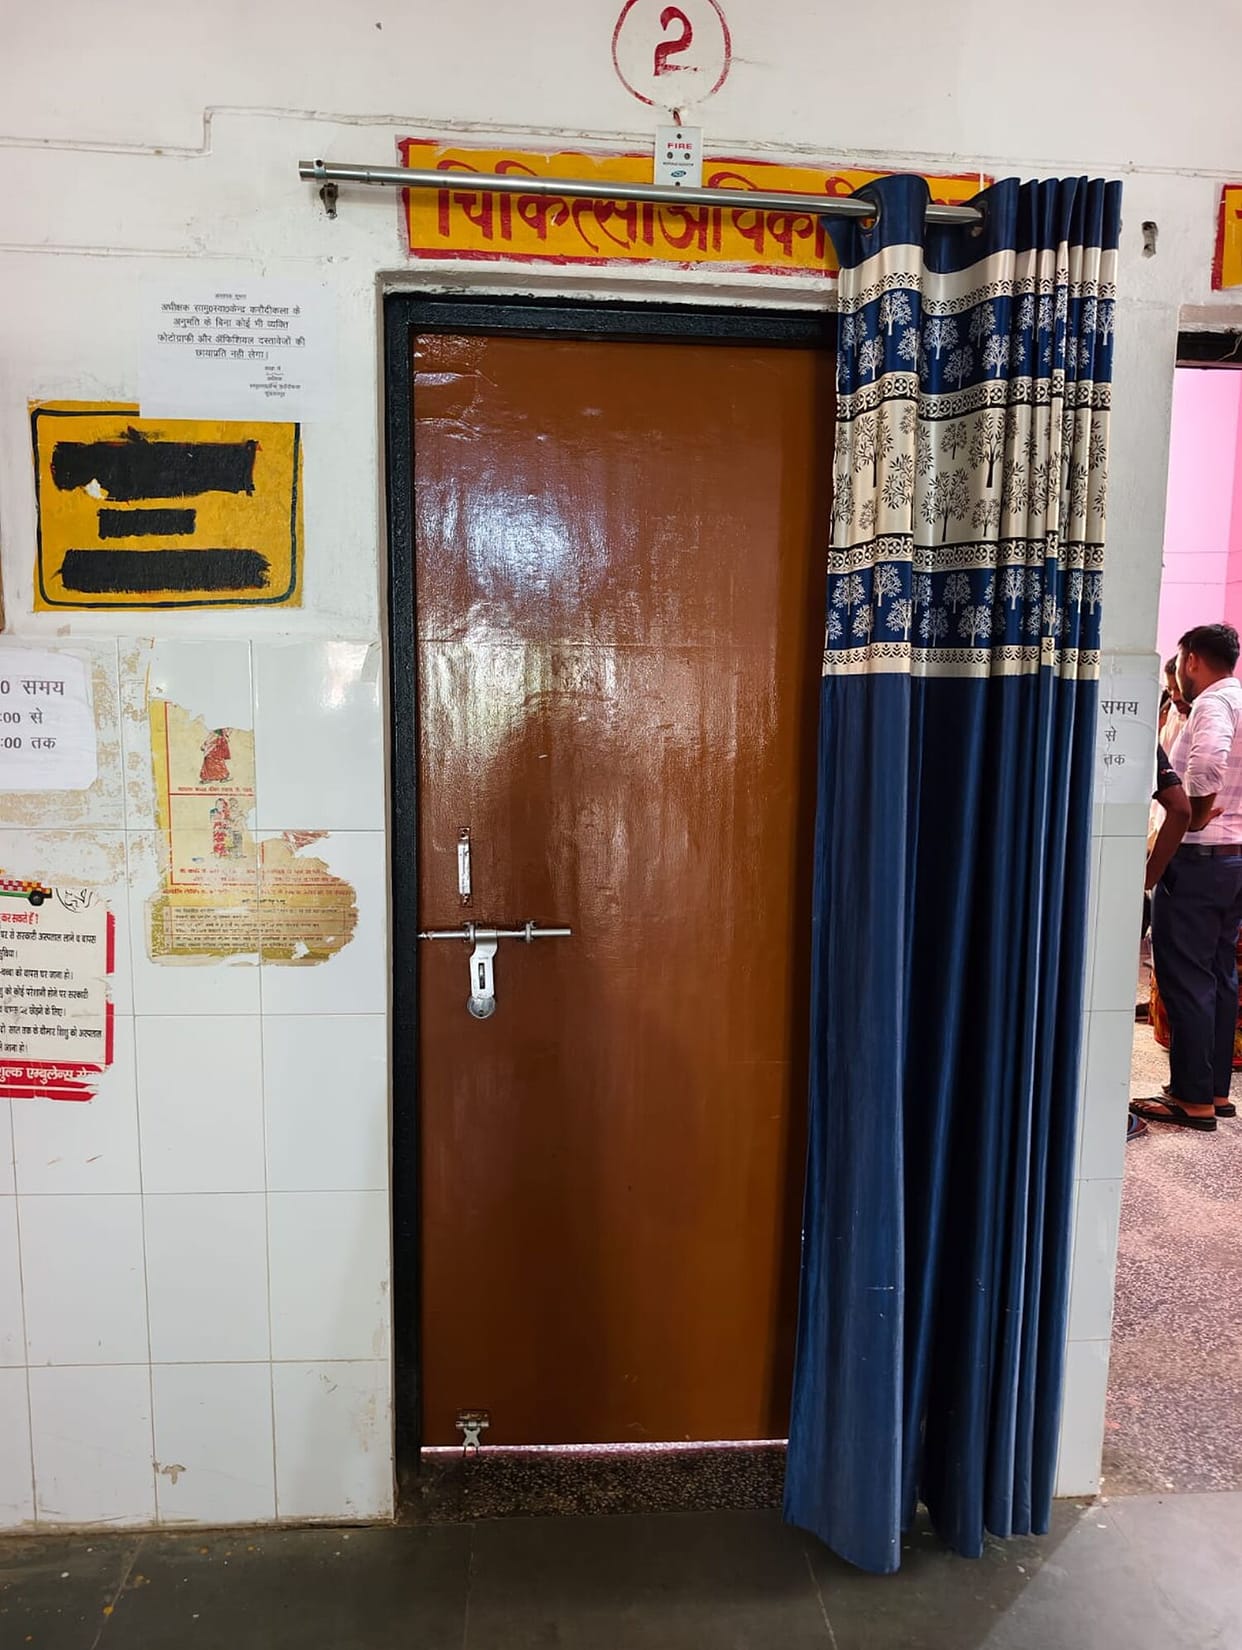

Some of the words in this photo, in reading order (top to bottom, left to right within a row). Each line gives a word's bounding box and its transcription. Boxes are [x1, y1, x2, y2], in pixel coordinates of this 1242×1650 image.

[653, 6, 698, 77] 2
[667, 142, 693, 150] FIRE
[173, 316, 200, 328] अनुमति
[204, 316, 211, 326] के
[215, 316, 232, 327] बिना
[236, 317, 250, 328] कोई
[255, 318, 263, 328] भी
[198, 333, 212, 342] और
[295, 336, 305, 346] की
[21, 680, 64, 695] समय
[1101, 700, 1139, 715] समय
[29, 707, 43, 724] से
[1104, 726, 1116, 742] से
[30, 737, 56, 749] तक
[1103, 754, 1125, 766] तक
